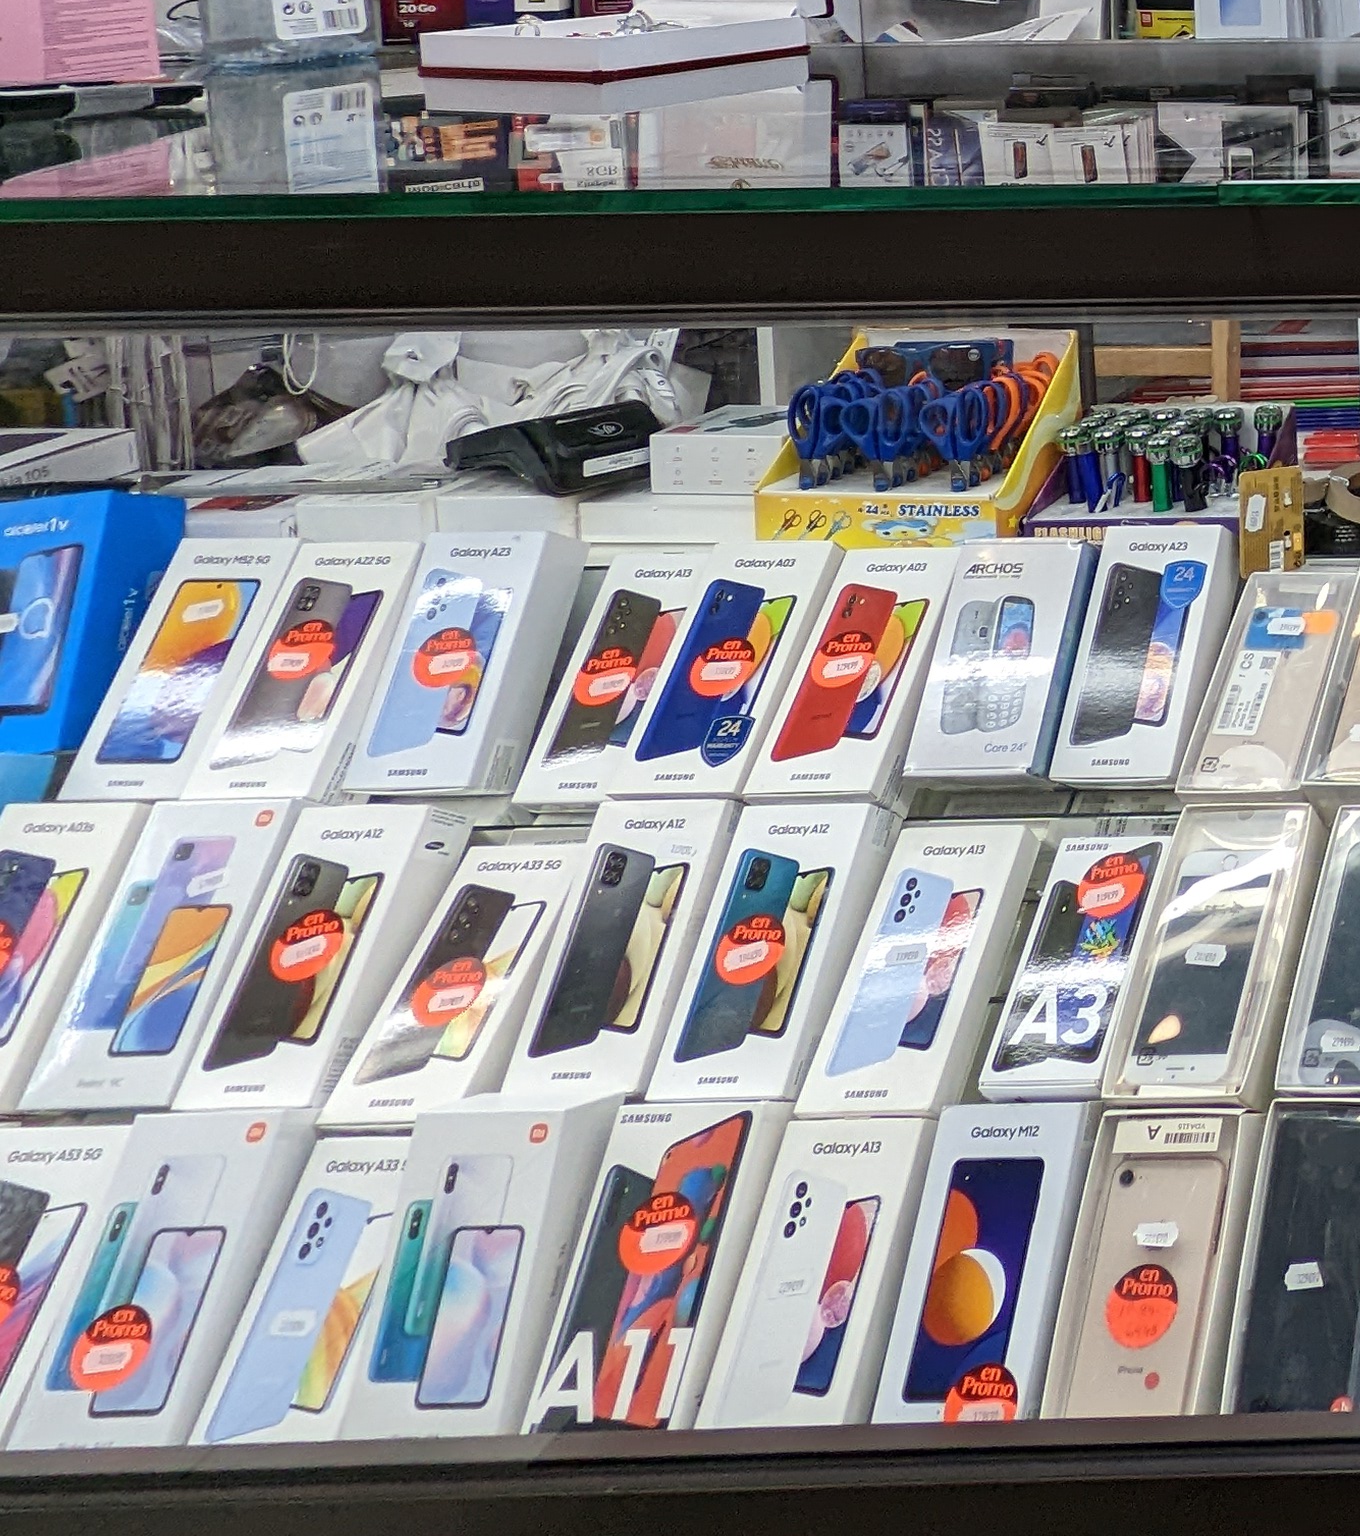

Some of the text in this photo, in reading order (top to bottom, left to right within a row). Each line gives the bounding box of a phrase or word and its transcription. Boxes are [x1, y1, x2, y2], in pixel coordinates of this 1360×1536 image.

[866, 503, 981, 518] 24 STAINLESS
[1129, 541, 1189, 554] Galaxy A23
[866, 562, 928, 574] Galaxy A03
[965, 562, 1024, 575] ARCHOS
[1173, 566, 1196, 581] 24
[706, 647, 752, 661] Promo
[826, 641, 872, 654] Promo
[715, 719, 740, 737] 24
[387, 768, 429, 778] SAMSUNG
[653, 772, 696, 781] SAMSUNG
[789, 772, 831, 781] SAMSUNG
[557, 781, 598, 790] SAMSUNG
[624, 819, 686, 832] Galaxy A12
[767, 823, 830, 838] Galaxy A12
[320, 828, 384, 843] Galaxy A12
[922, 844, 987, 858] Galaxy A13
[1064, 842, 1109, 852] SAMSUNG
[285, 921, 339, 941] Promo
[733, 925, 782, 942] Promo
[550, 1070, 593, 1081] SAMSUNG
[696, 1075, 740, 1086] SAMSUNG
[843, 1088, 889, 1100] SAMSUNG
[620, 1113, 673, 1125] SAMSUNG
[970, 1125, 1040, 1140] Galaxy M12
[812, 1141, 882, 1156] Galaxy A13
[325, 1159, 398, 1174] Galaxy A33
[634, 1204, 691, 1227] Promo
[1138, 1267, 1161, 1282] en
[1121, 1279, 1174, 1299] Promo
[91, 1320, 149, 1340] Promo
[523, 1326, 696, 1435] A11
[979, 1366, 1003, 1382] en
[961, 1379, 1016, 1399] Promo
